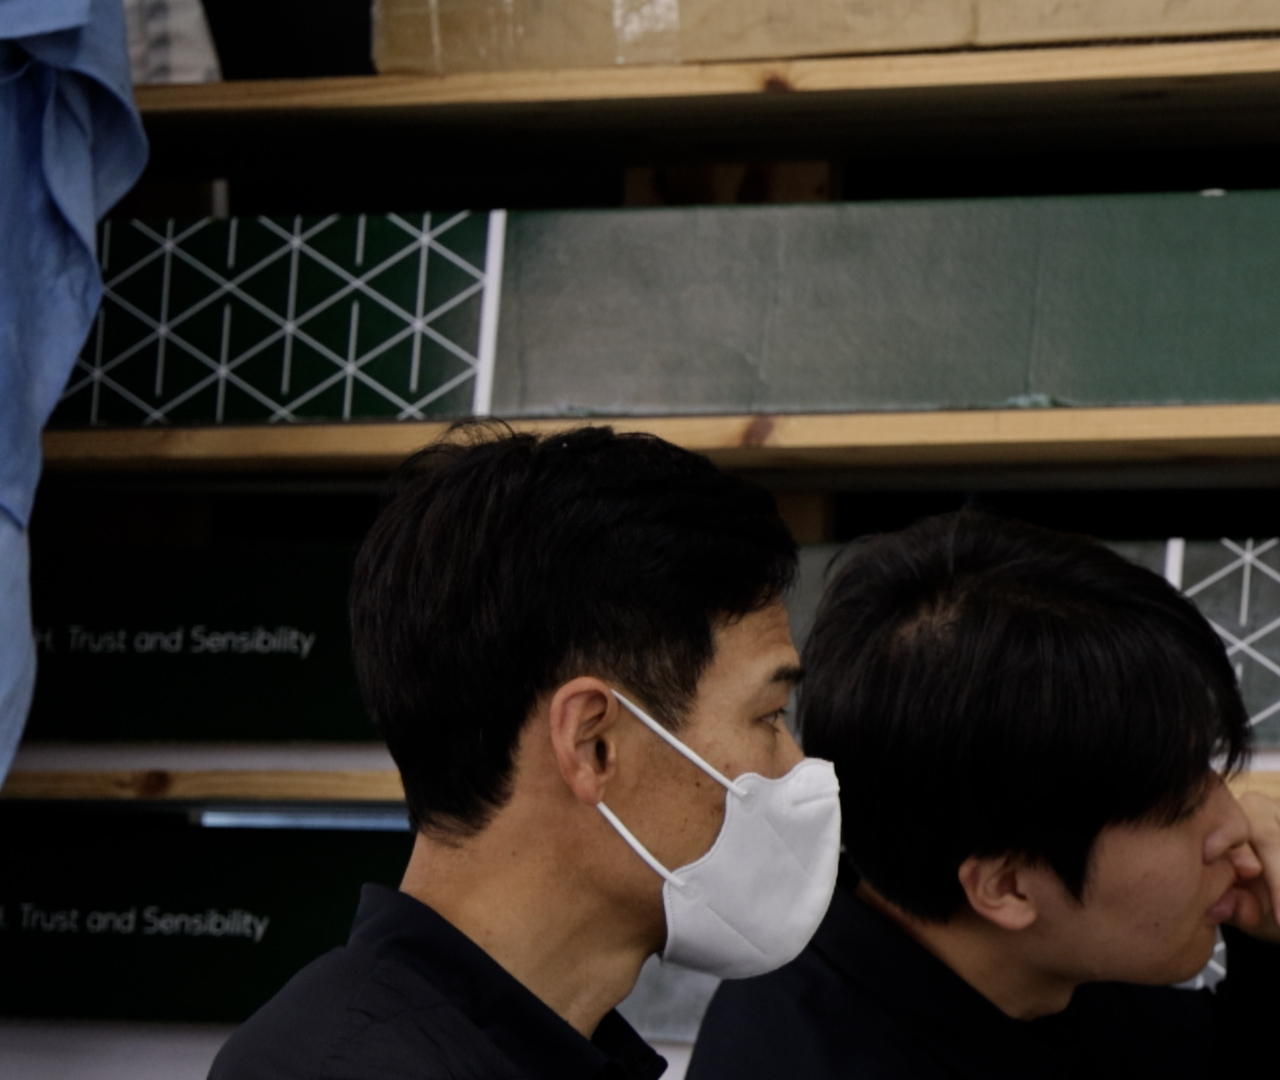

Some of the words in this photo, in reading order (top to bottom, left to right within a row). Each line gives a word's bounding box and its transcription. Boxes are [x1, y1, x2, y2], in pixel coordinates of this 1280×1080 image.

[67, 624, 128, 654] Trust
[133, 625, 184, 654] and
[189, 624, 318, 661] Sensibility
[18, 902, 81, 934] Trust
[86, 905, 138, 935] and
[142, 904, 271, 945] Sensibility
